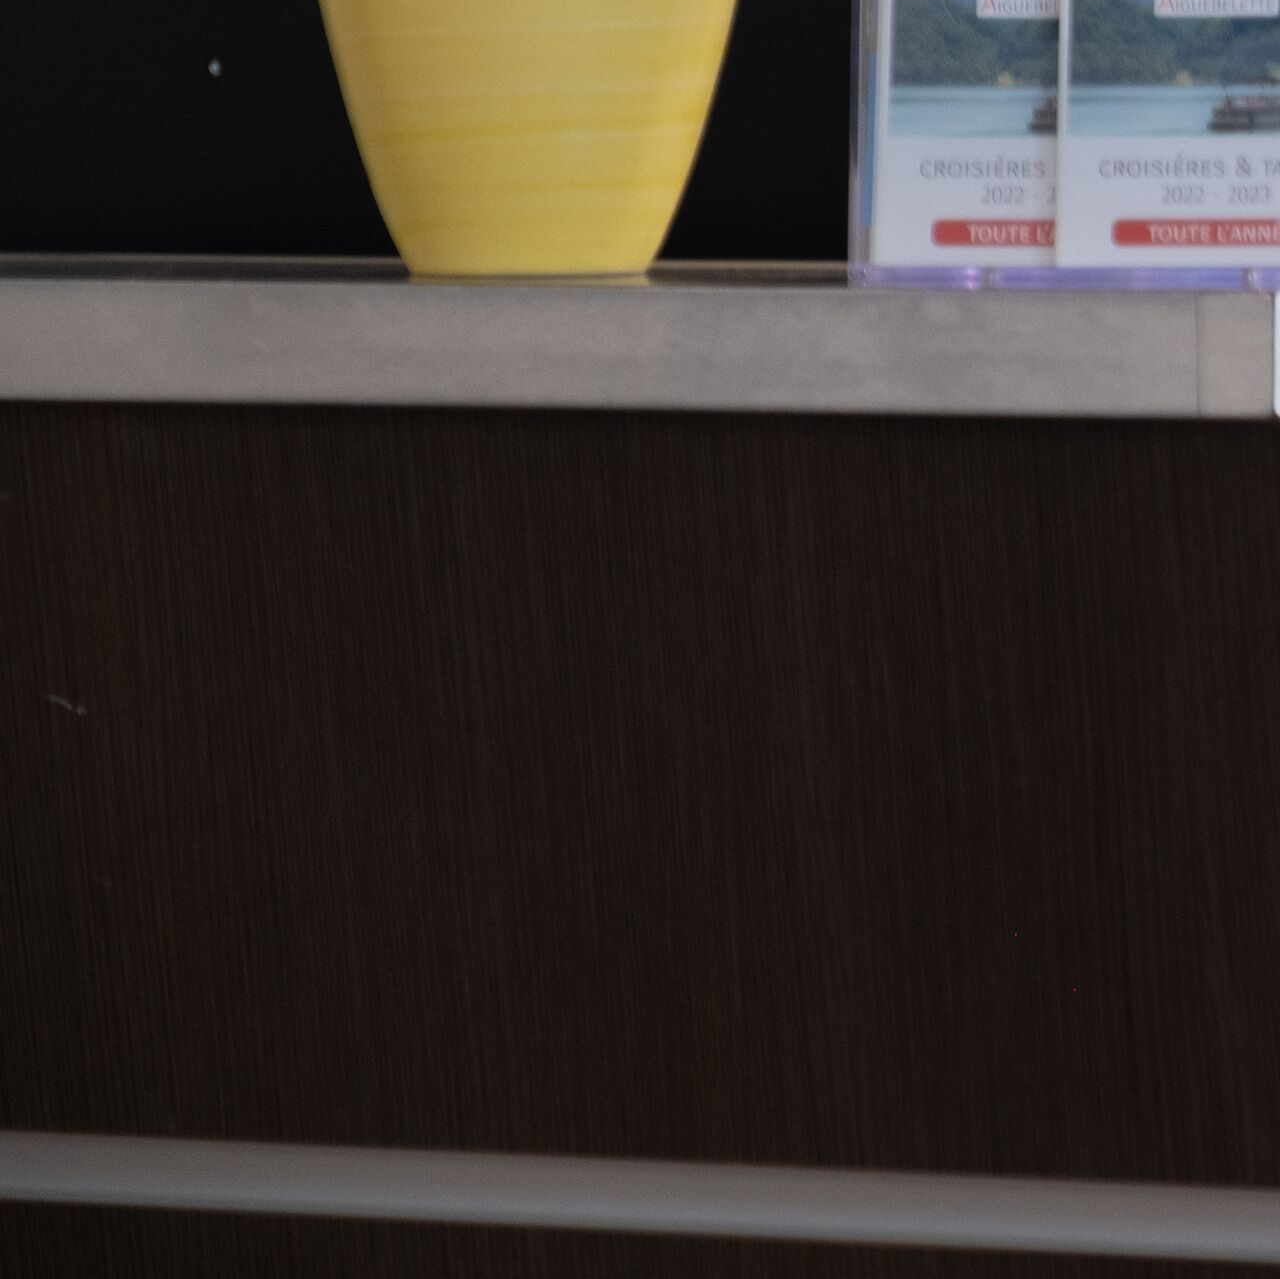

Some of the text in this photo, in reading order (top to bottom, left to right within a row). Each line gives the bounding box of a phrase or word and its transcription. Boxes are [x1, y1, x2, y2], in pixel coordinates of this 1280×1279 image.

[919, 154, 1046, 180] CROISIÈRES
[1099, 154, 1226, 179] CROISIÈRES
[1235, 156, 1252, 178] &
[981, 185, 1025, 205] 2022
[1161, 185, 1205, 204] 2022
[1226, 185, 1272, 204] 2023
[967, 223, 1032, 244] TOUTE
[1147, 223, 1211, 244] TOUTE
